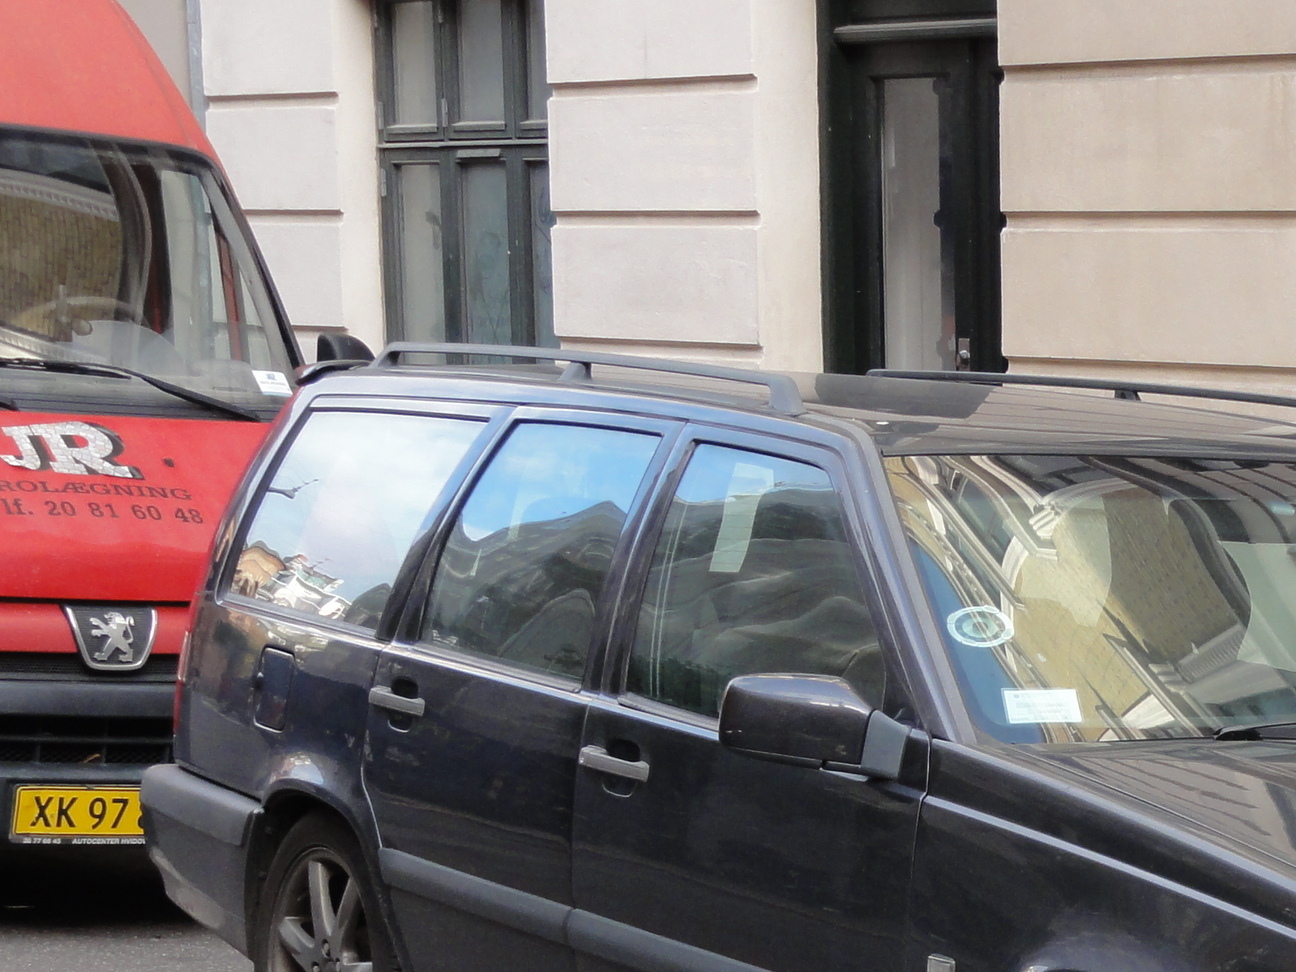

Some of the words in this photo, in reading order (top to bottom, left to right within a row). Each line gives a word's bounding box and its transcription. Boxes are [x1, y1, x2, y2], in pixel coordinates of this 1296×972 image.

[44, 500, 76, 517] 20
[88, 503, 119, 519] 81
[131, 504, 162, 521] 60
[174, 507, 204, 524] 48
[30, 796, 78, 828] XK
[88, 797, 129, 830] 97
